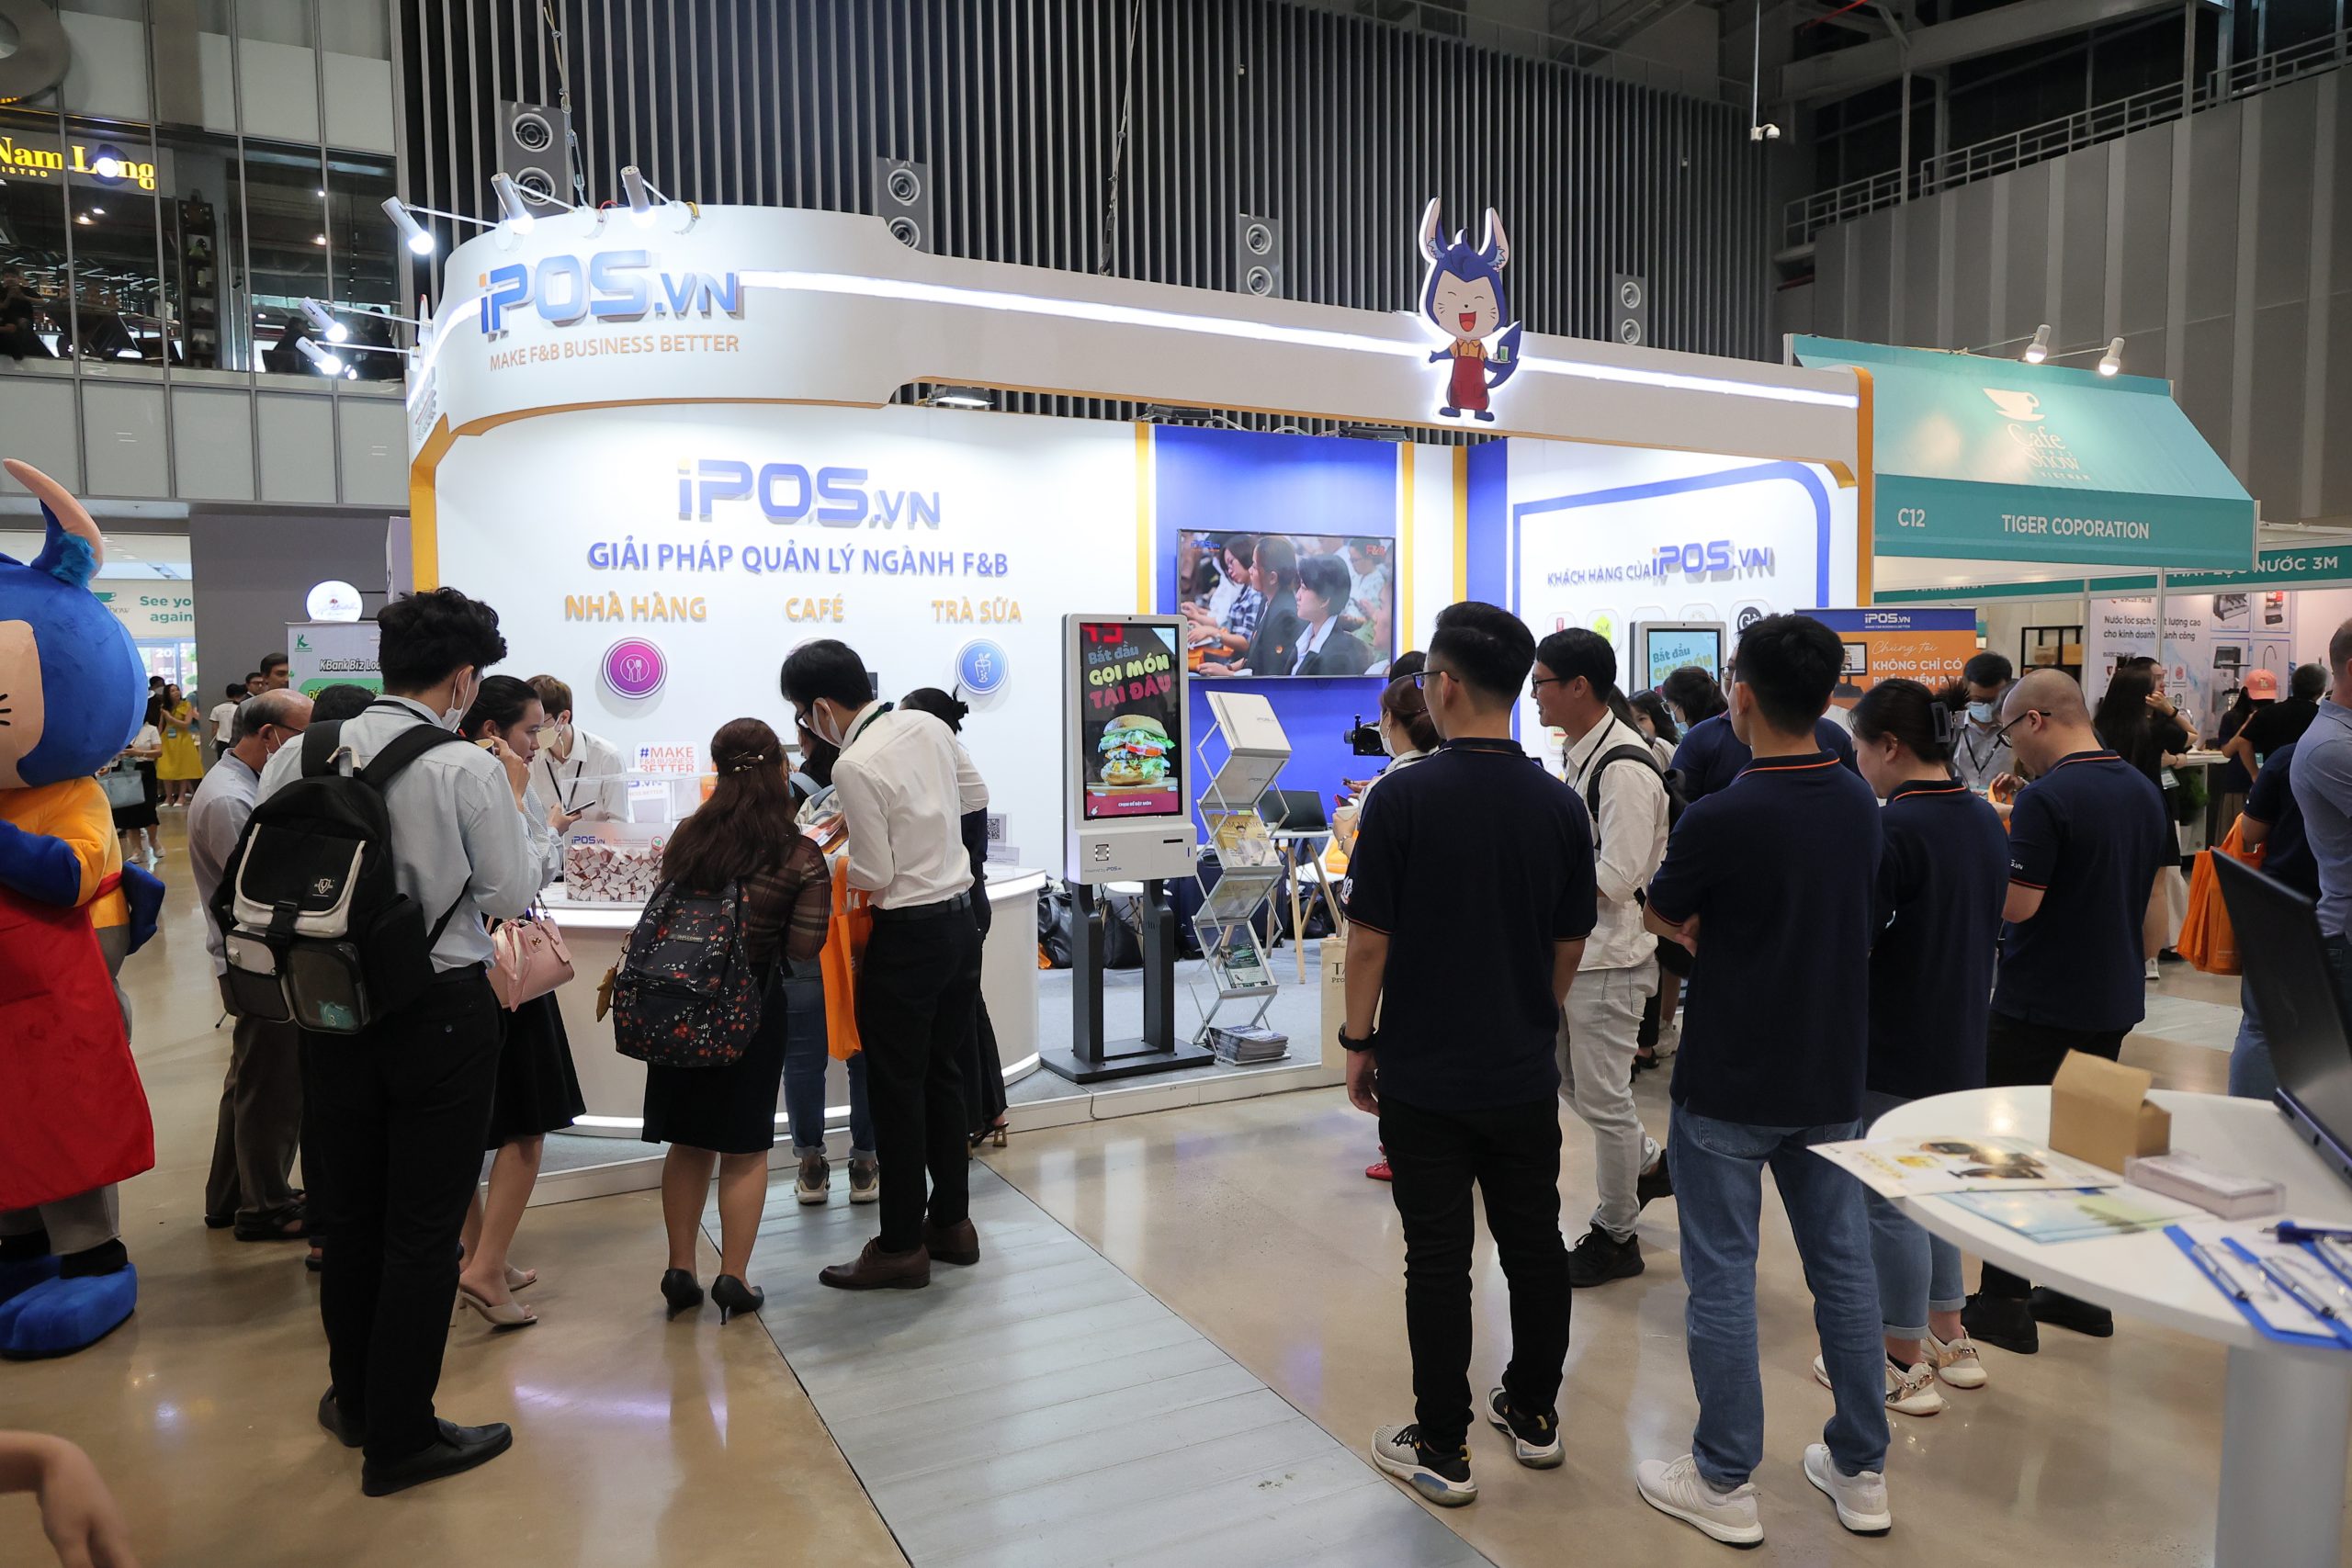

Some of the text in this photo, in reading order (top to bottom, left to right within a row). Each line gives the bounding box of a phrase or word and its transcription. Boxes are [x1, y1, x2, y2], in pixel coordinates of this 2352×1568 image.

[0, 137, 63, 170] Nam
[479, 250, 738, 335] iPOS.VN
[490, 333, 739, 371] MAKE F&B BUSINESS BETTER
[677, 457, 940, 526] iPOS.VN
[1897, 508, 1926, 528] C12
[2001, 513, 2149, 539] TIGER COPORATION
[588, 535, 1009, 577] GIẢI PHÁP QUẢN LÝ NGÀNH F&B
[1547, 540, 1768, 586] KHÁCH HÀNG CỦA iPOS.VN
[2312, 556, 2339, 571] 3M
[140, 596, 168, 606] See
[565, 591, 707, 622] NHÀ HÀNG
[785, 593, 844, 622] CAFÉ
[932, 596, 1023, 623] TRÀ SỮA
[150, 612, 193, 623] again
[1865, 614, 1911, 624] iPOS.VN
[2103, 629, 2117, 638] cho
[2119, 629, 2133, 638] kinh
[1088, 641, 1139, 664] Bắt đầu
[1653, 647, 1671, 663] Bắt
[1872, 656, 1963, 671] KHÔNG CHỈ CÓ
[320, 659, 348, 671] KBank
[349, 659, 365, 671] Biz
[1089, 652, 1170, 688] GỌI MÓN
[1089, 673, 1171, 711] TẠI ĐÂU
[639, 747, 694, 758] #MAKE
[1332, 963, 1345, 975] T
